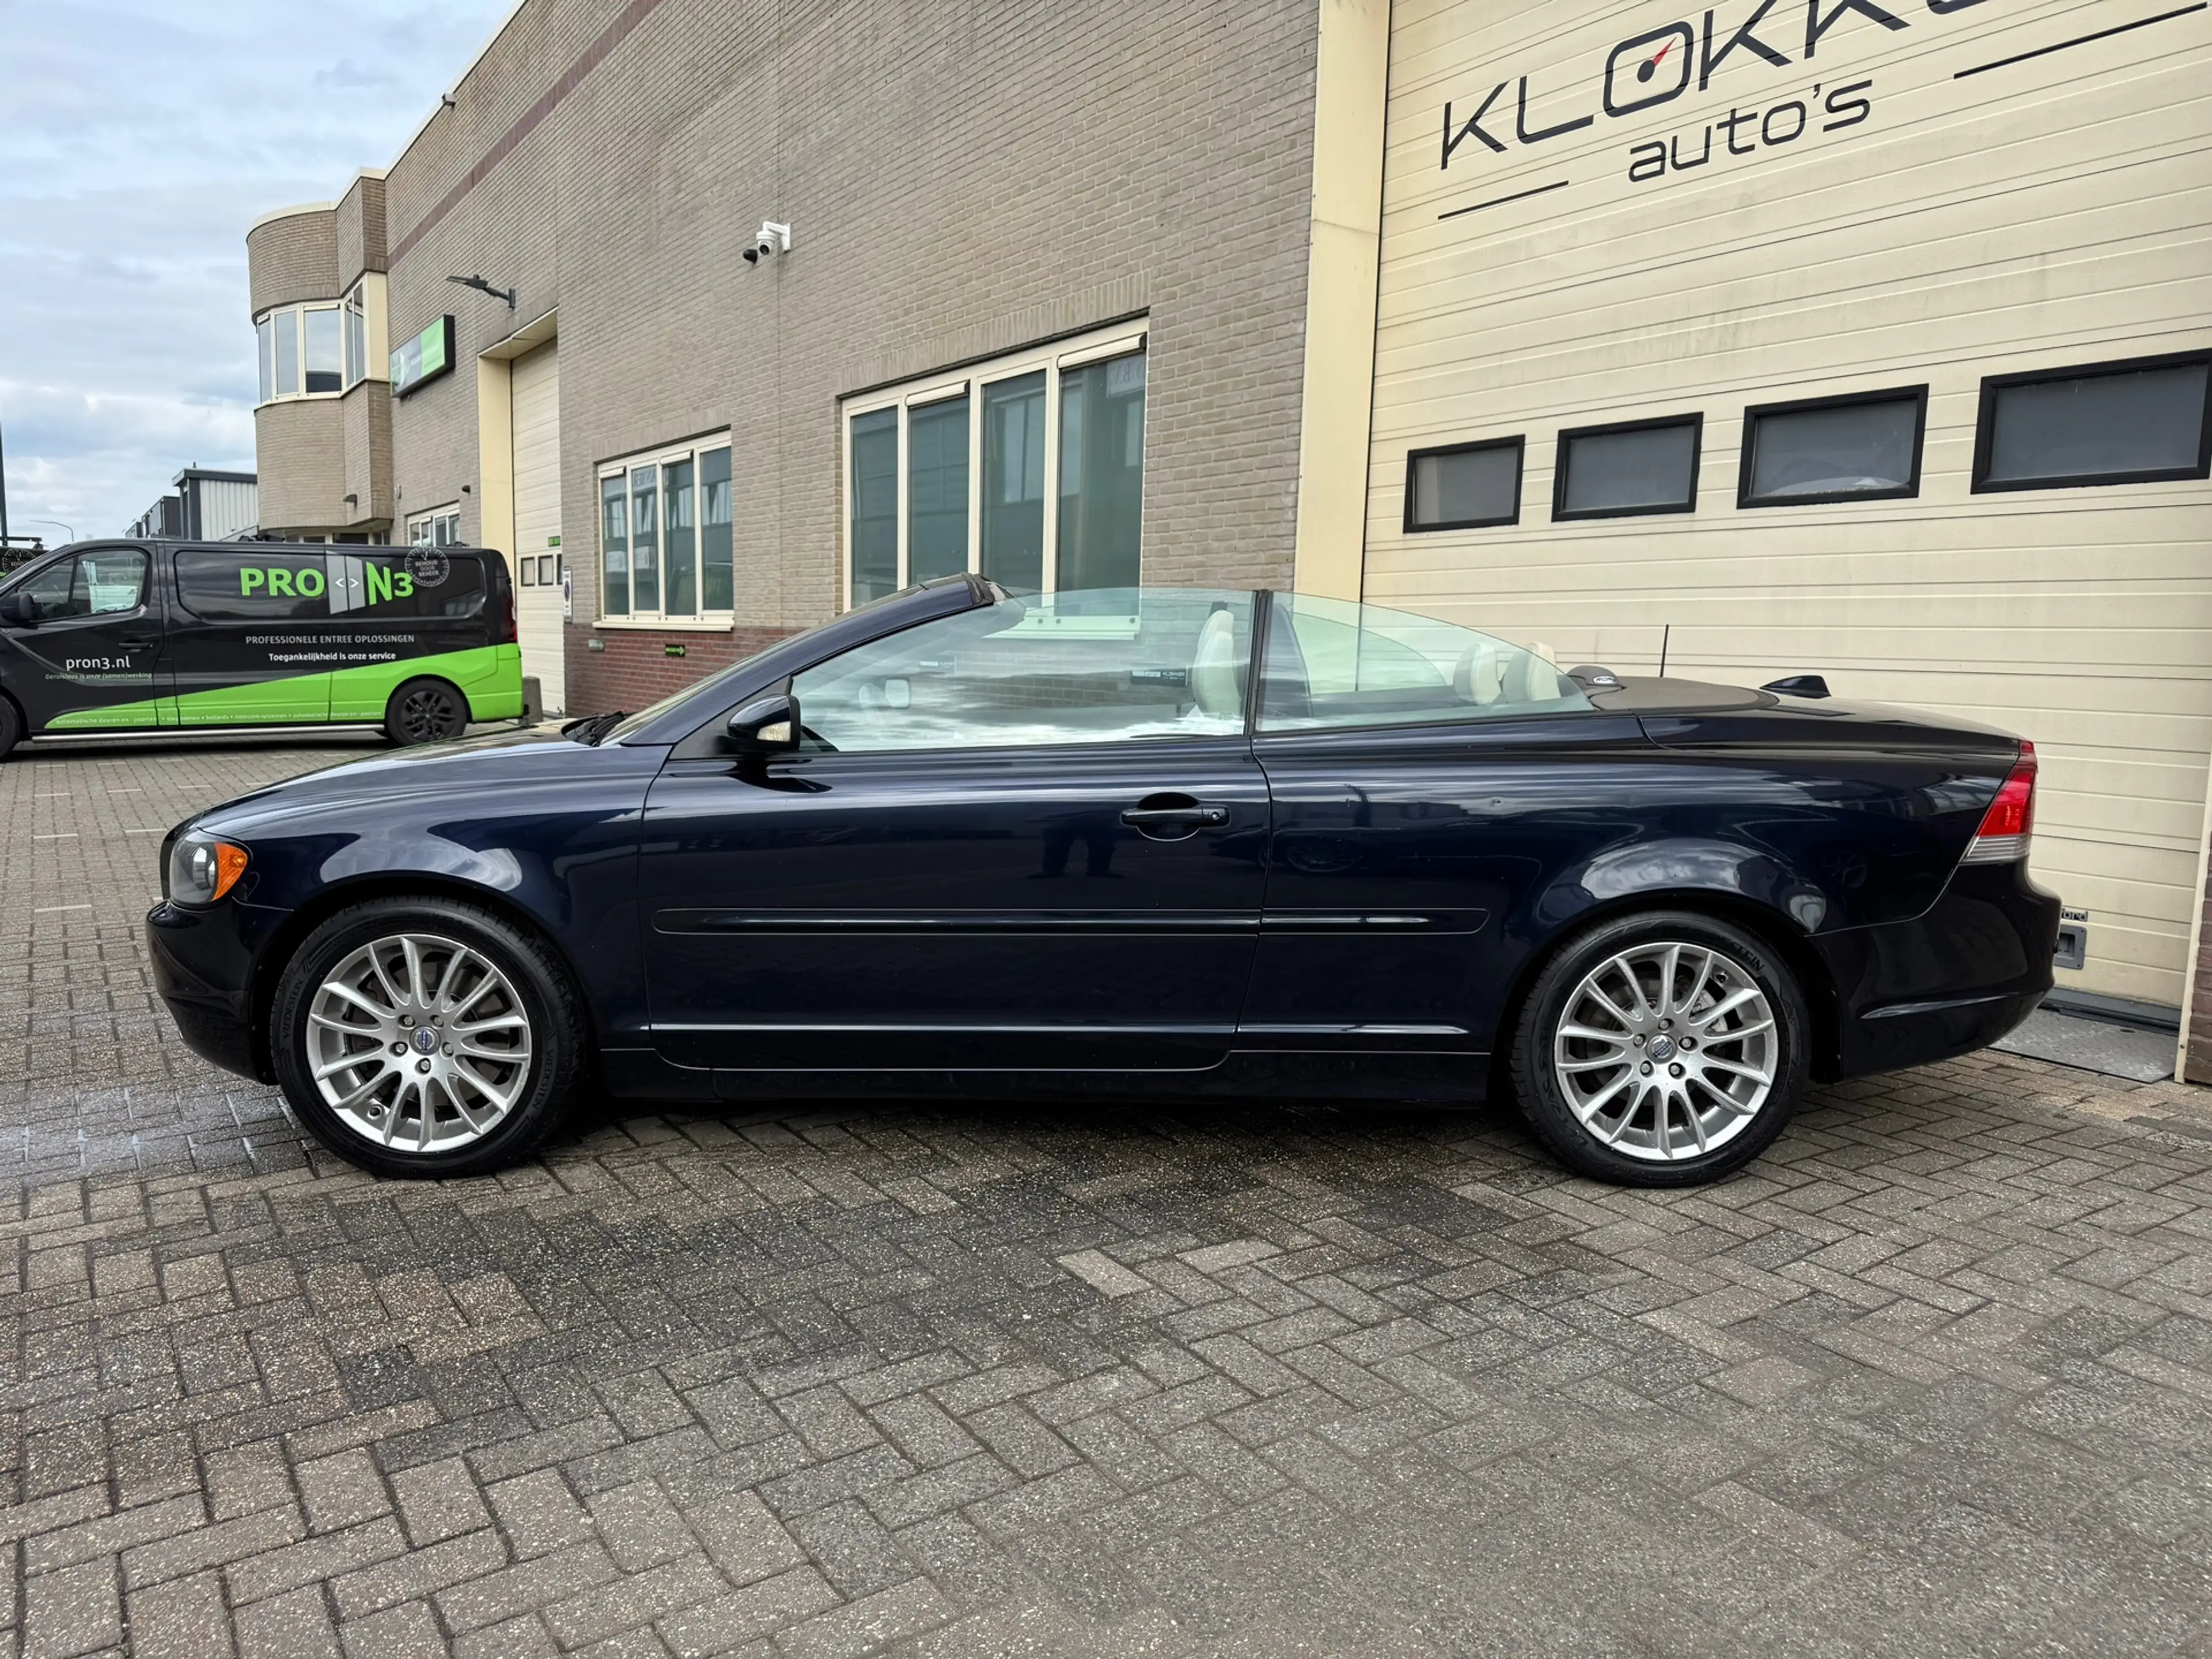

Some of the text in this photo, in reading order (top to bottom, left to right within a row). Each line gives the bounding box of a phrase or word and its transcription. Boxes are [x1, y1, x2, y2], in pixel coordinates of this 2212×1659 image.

[1441, 0, 1987, 170] KLOKK
[1628, 79, 1873, 183] auto's
[240, 561, 414, 605] PRO N3
[245, 634, 415, 644] PROFESSIONELE ENTREE OPLOSSINGEN
[66, 655, 131, 671] pron3.nl
[268, 652, 337, 662] Toegankelijkheid
[340, 652, 346, 660] is
[369, 652, 396, 660] service
